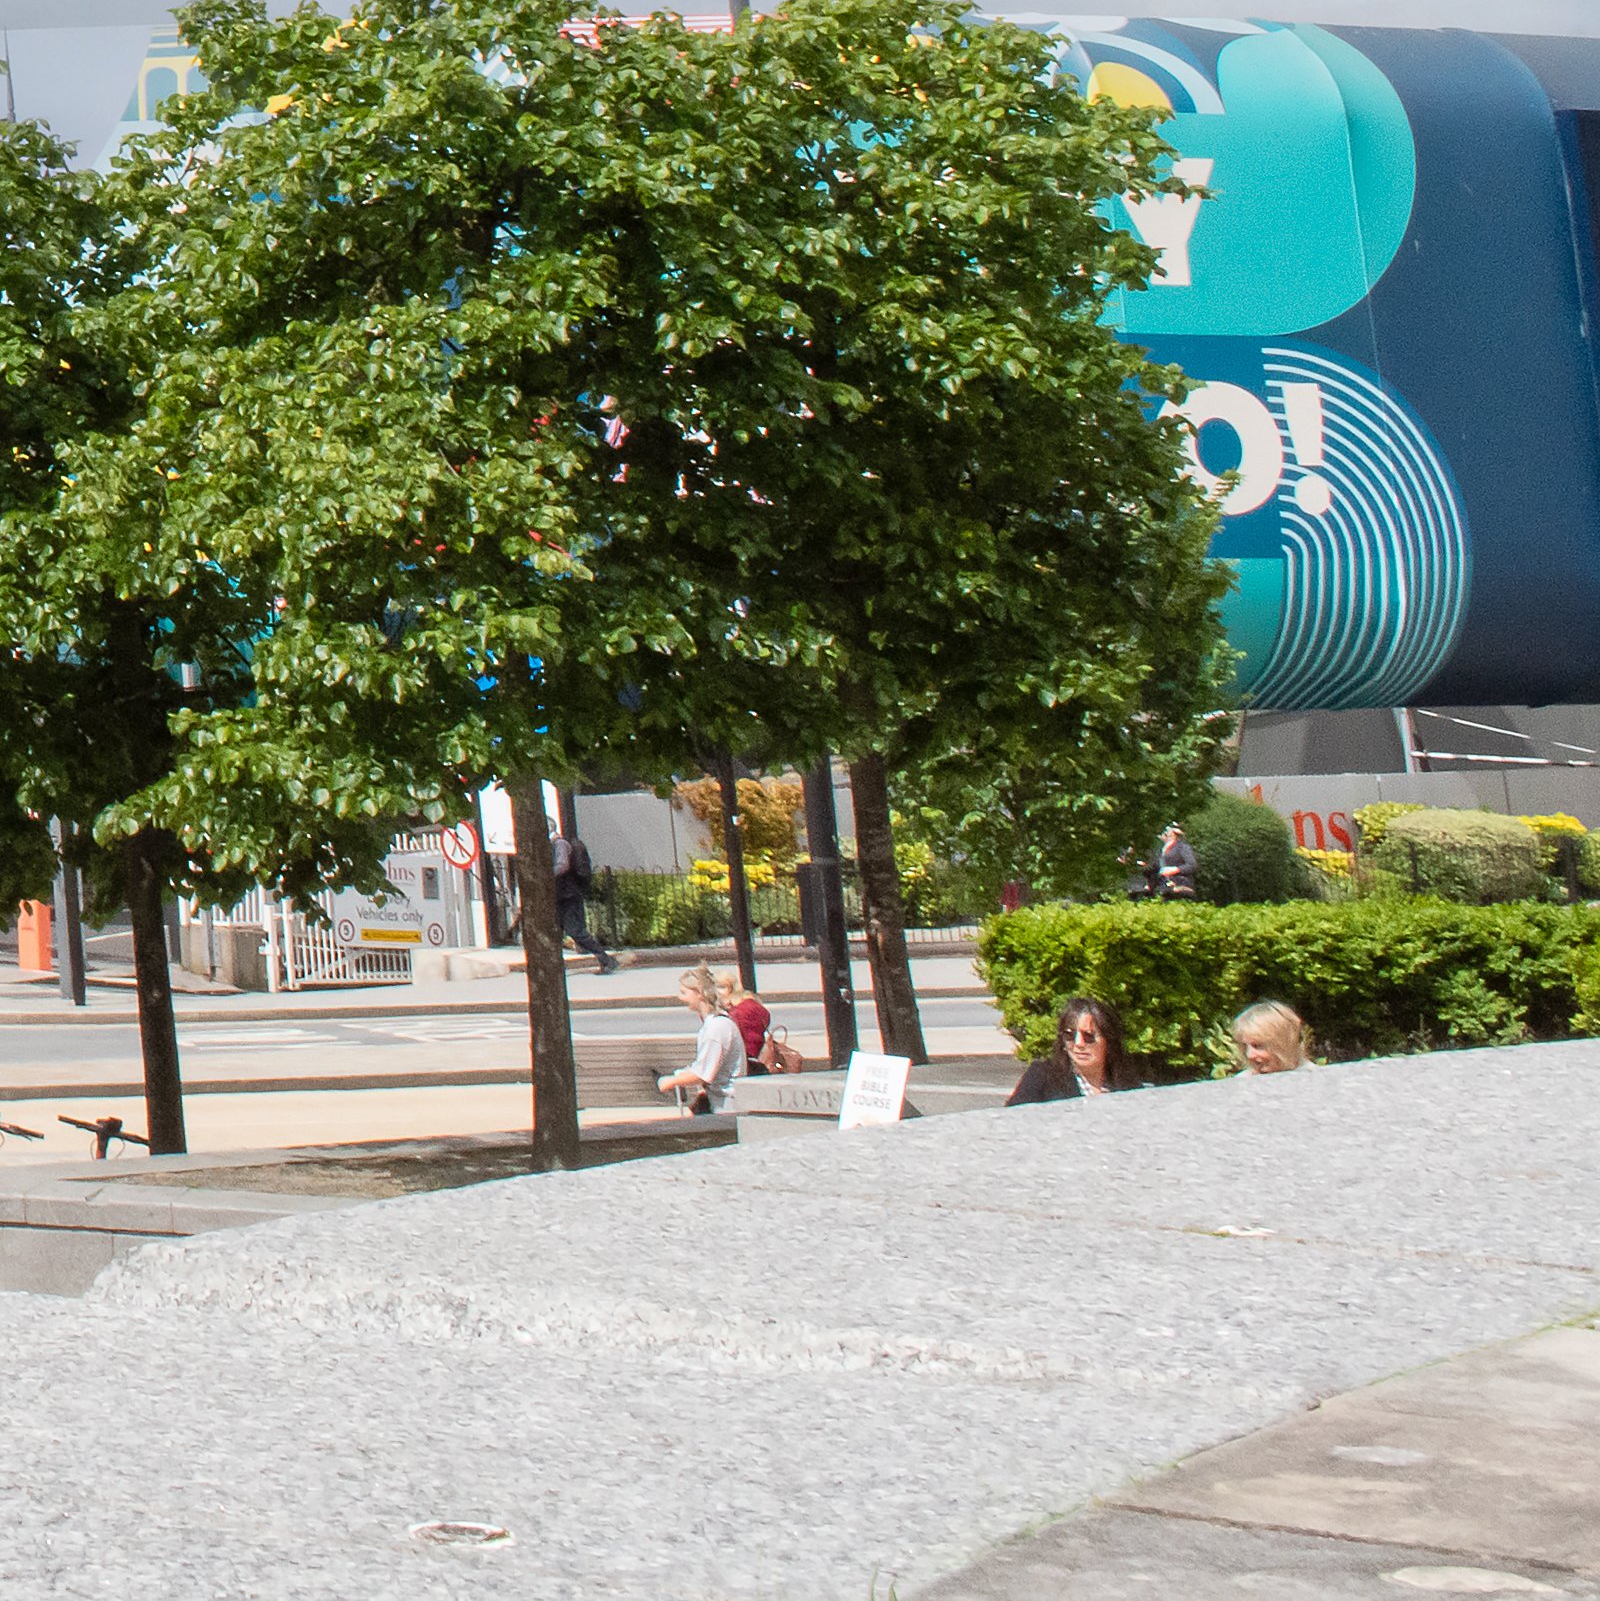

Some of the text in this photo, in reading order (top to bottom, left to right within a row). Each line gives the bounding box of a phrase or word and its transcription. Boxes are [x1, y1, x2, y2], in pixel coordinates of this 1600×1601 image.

[356, 905, 424, 926] Vehicles only
[861, 1079, 889, 1095] BIBLE
[852, 1093, 893, 1110] COURSE
